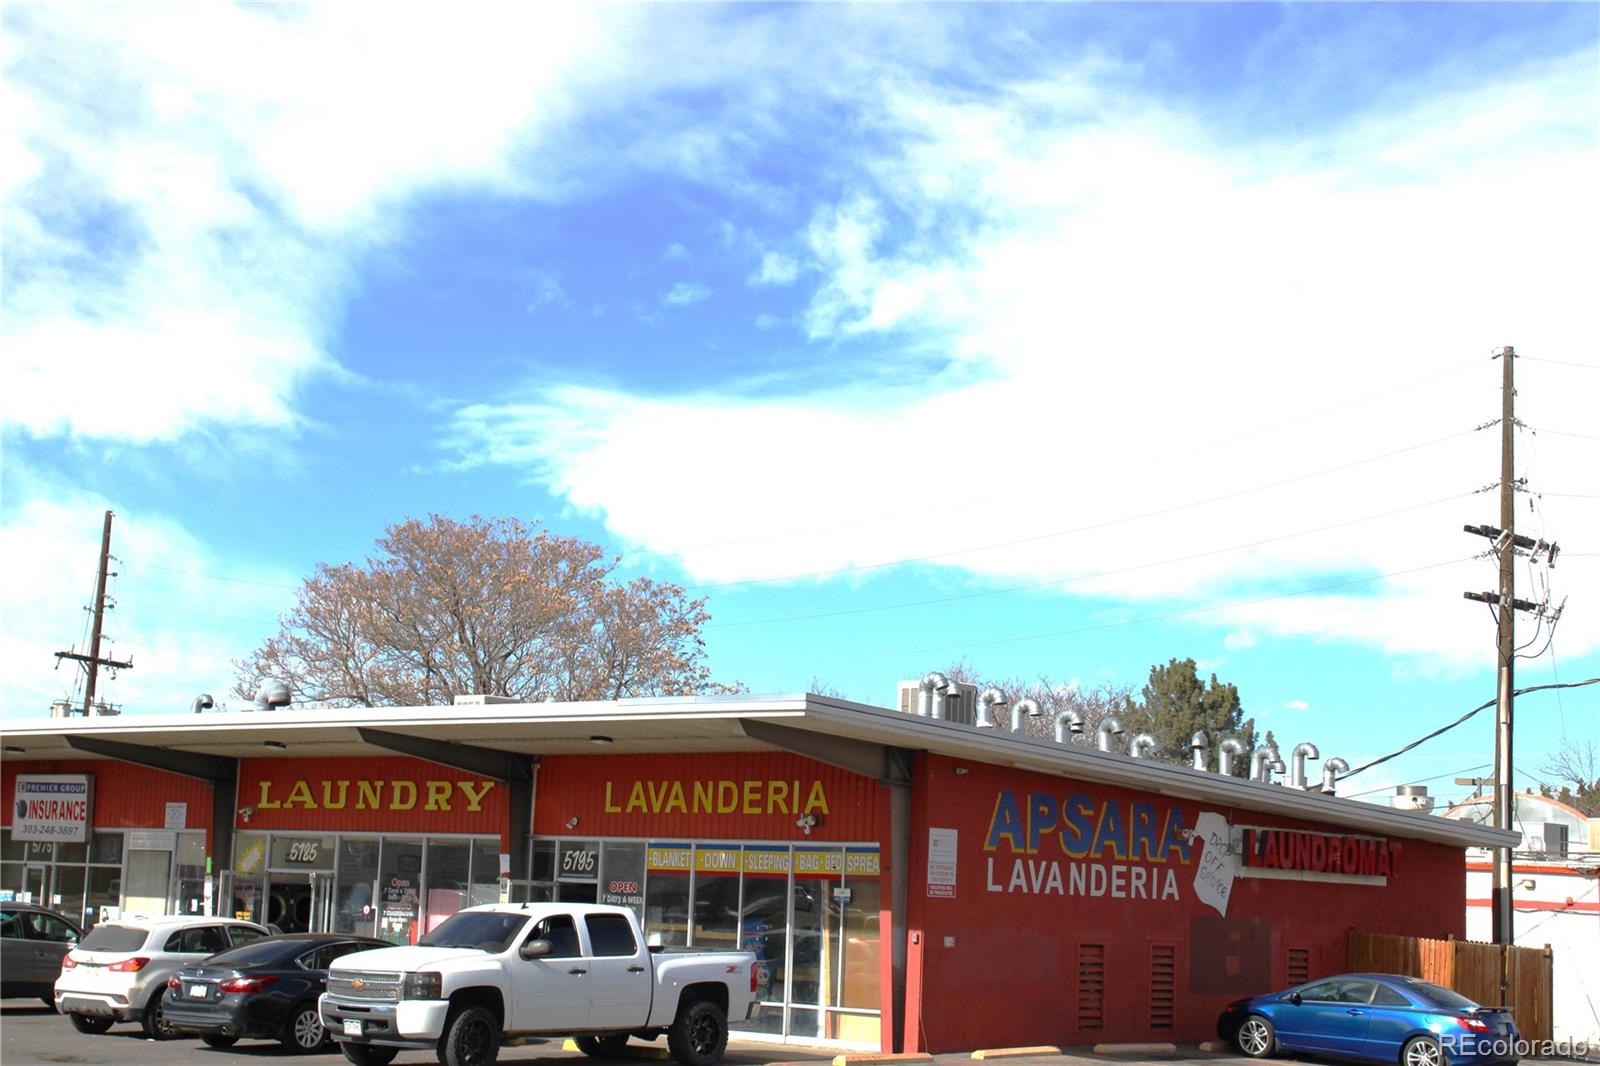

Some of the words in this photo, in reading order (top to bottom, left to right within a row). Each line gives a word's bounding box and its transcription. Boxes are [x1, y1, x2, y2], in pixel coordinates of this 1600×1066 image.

[258, 781, 495, 811] LAUNDRY
[605, 781, 829, 814] LAVANDERIA
[29, 800, 86, 821] INSURANCE
[22, 824, 79, 835] 303-248-3897
[983, 789, 1191, 864] APSARA
[289, 842, 318, 861] 5185
[563, 850, 595, 871] 5195
[652, 851, 691, 867] BLANKET
[704, 853, 736, 868] DOWN
[749, 853, 789, 870] SLEEPING
[800, 854, 819, 870] BAG
[825, 854, 842, 871] BED
[1243, 828, 1402, 877] LAUNDROMAT
[609, 881, 637, 893] OPEN
[986, 857, 1180, 900] LAVANDERIA
